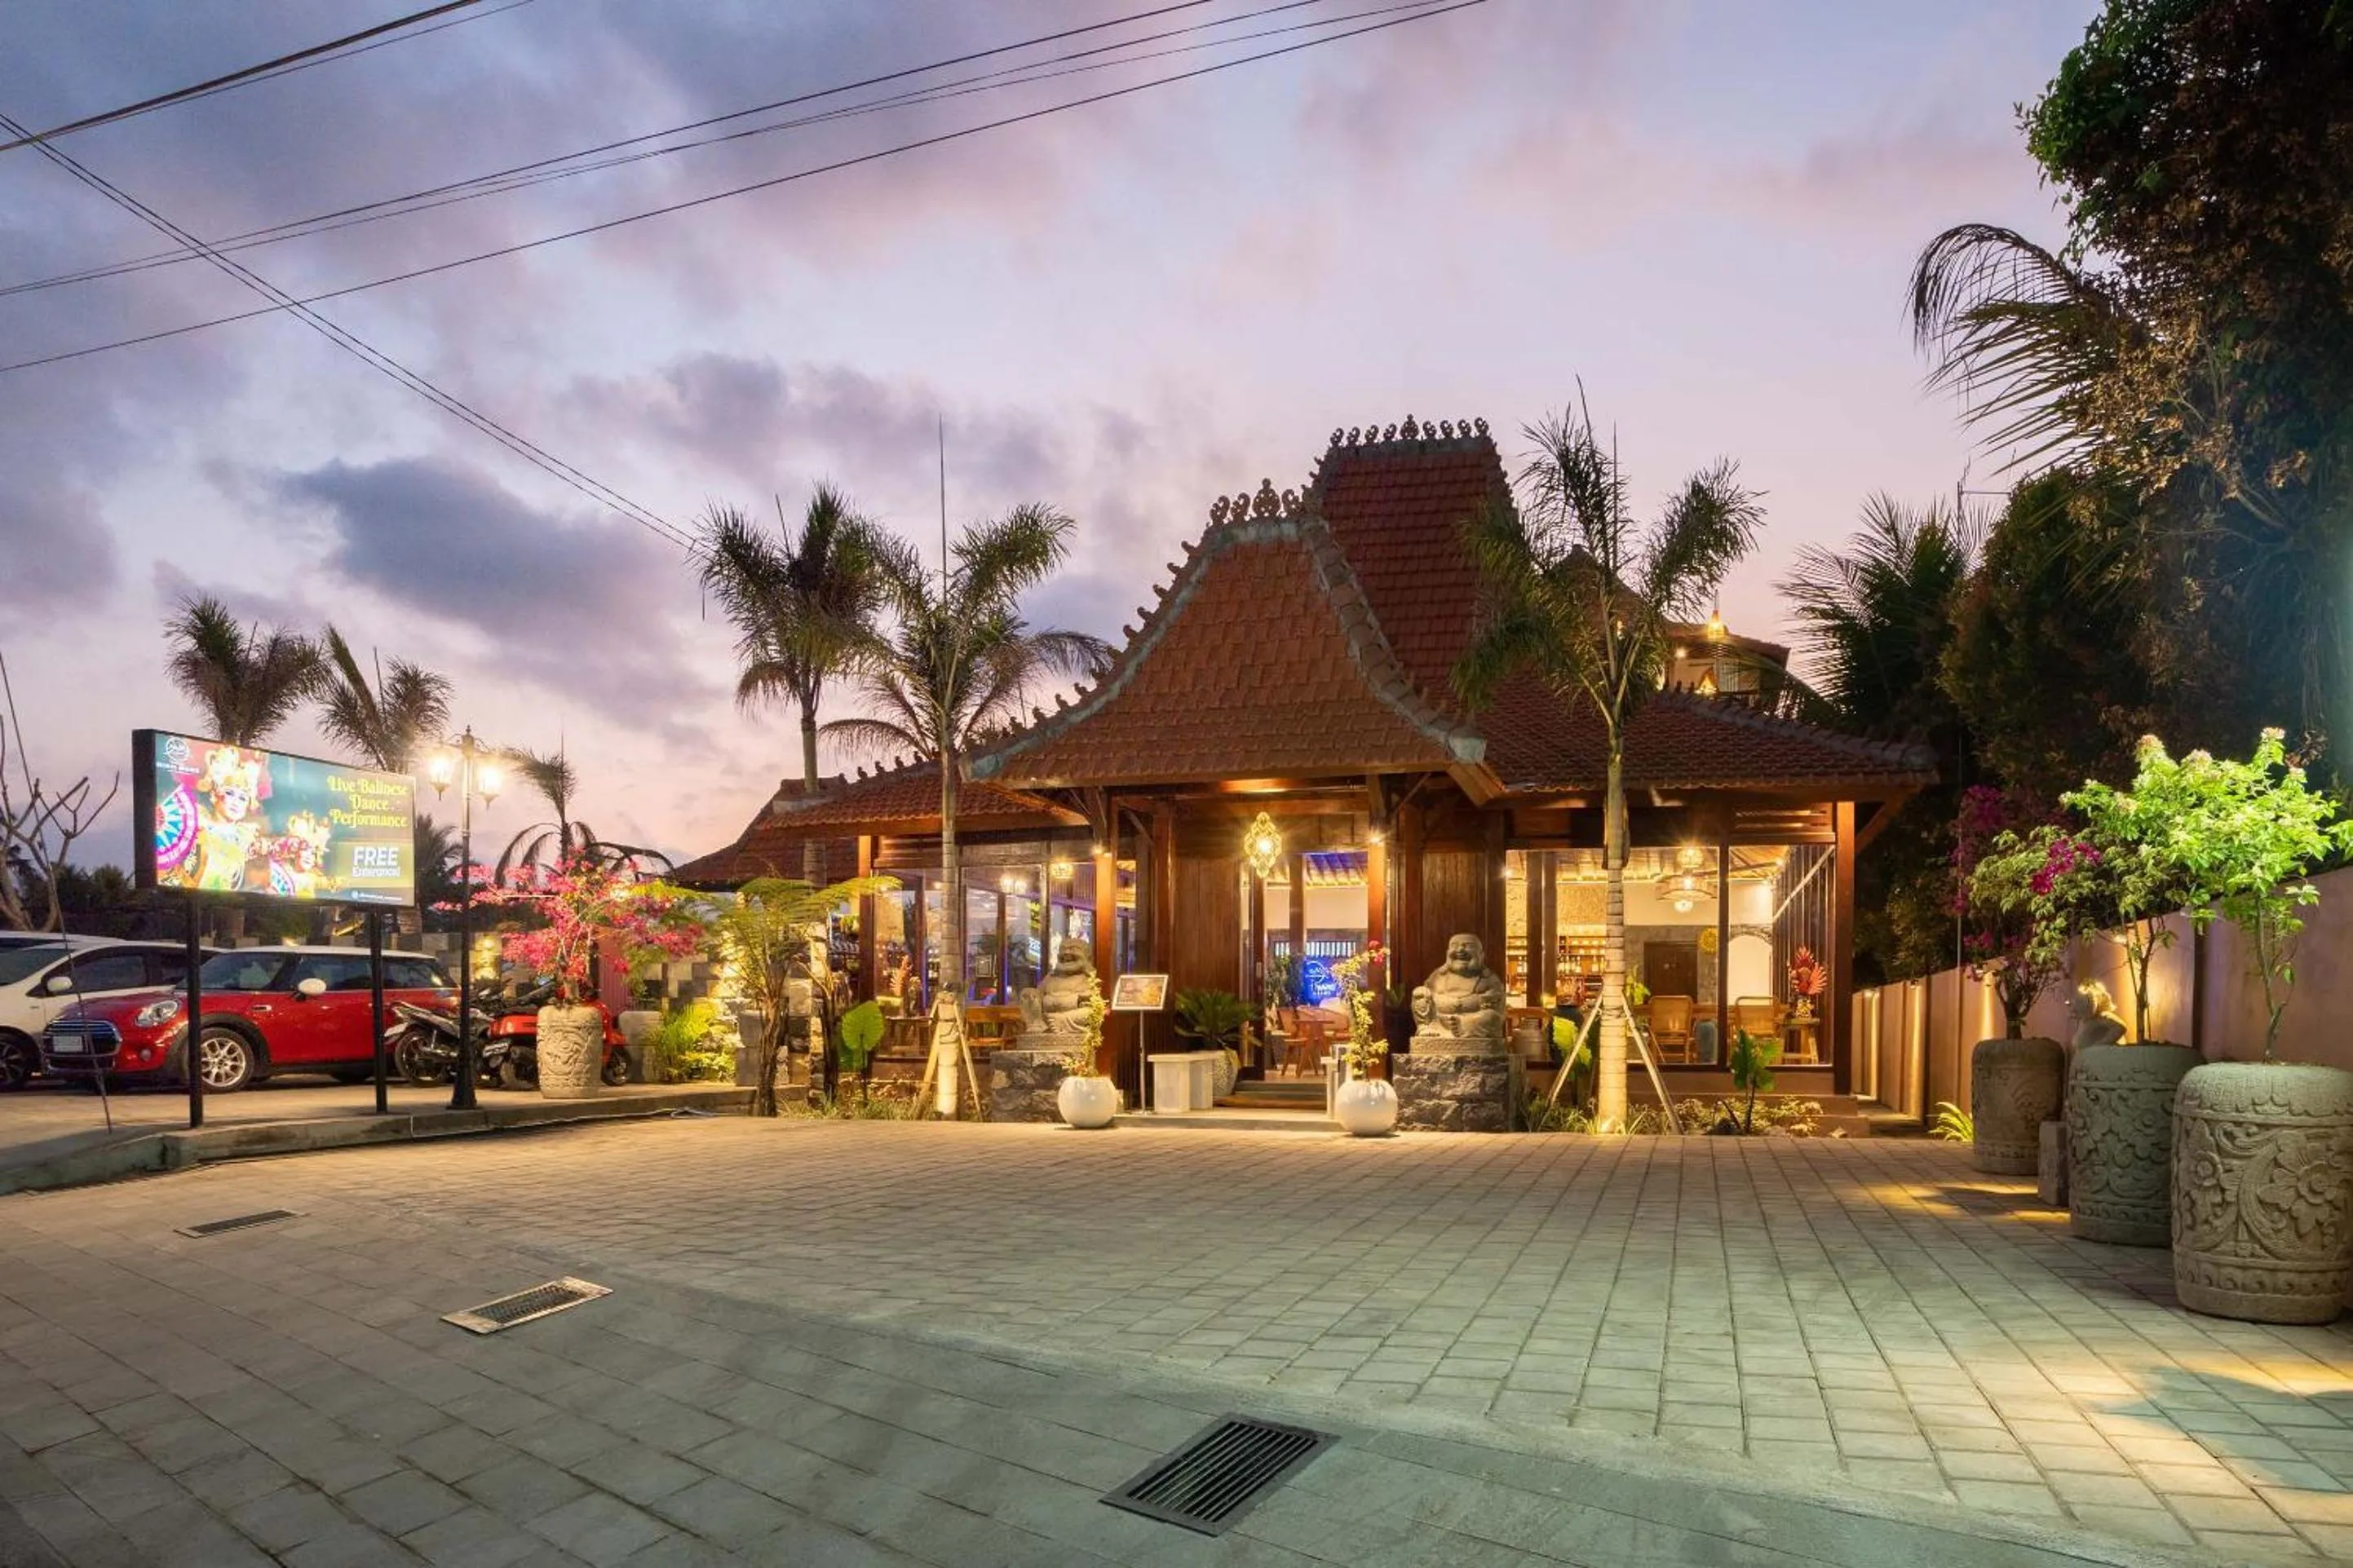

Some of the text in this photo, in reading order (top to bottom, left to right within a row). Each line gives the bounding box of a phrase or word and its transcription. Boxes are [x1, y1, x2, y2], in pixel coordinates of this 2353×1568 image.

[326, 775, 408, 796] Live Balinese
[349, 794, 389, 811] Dance
[329, 808, 408, 828] Performance
[353, 846, 399, 866] FREE
